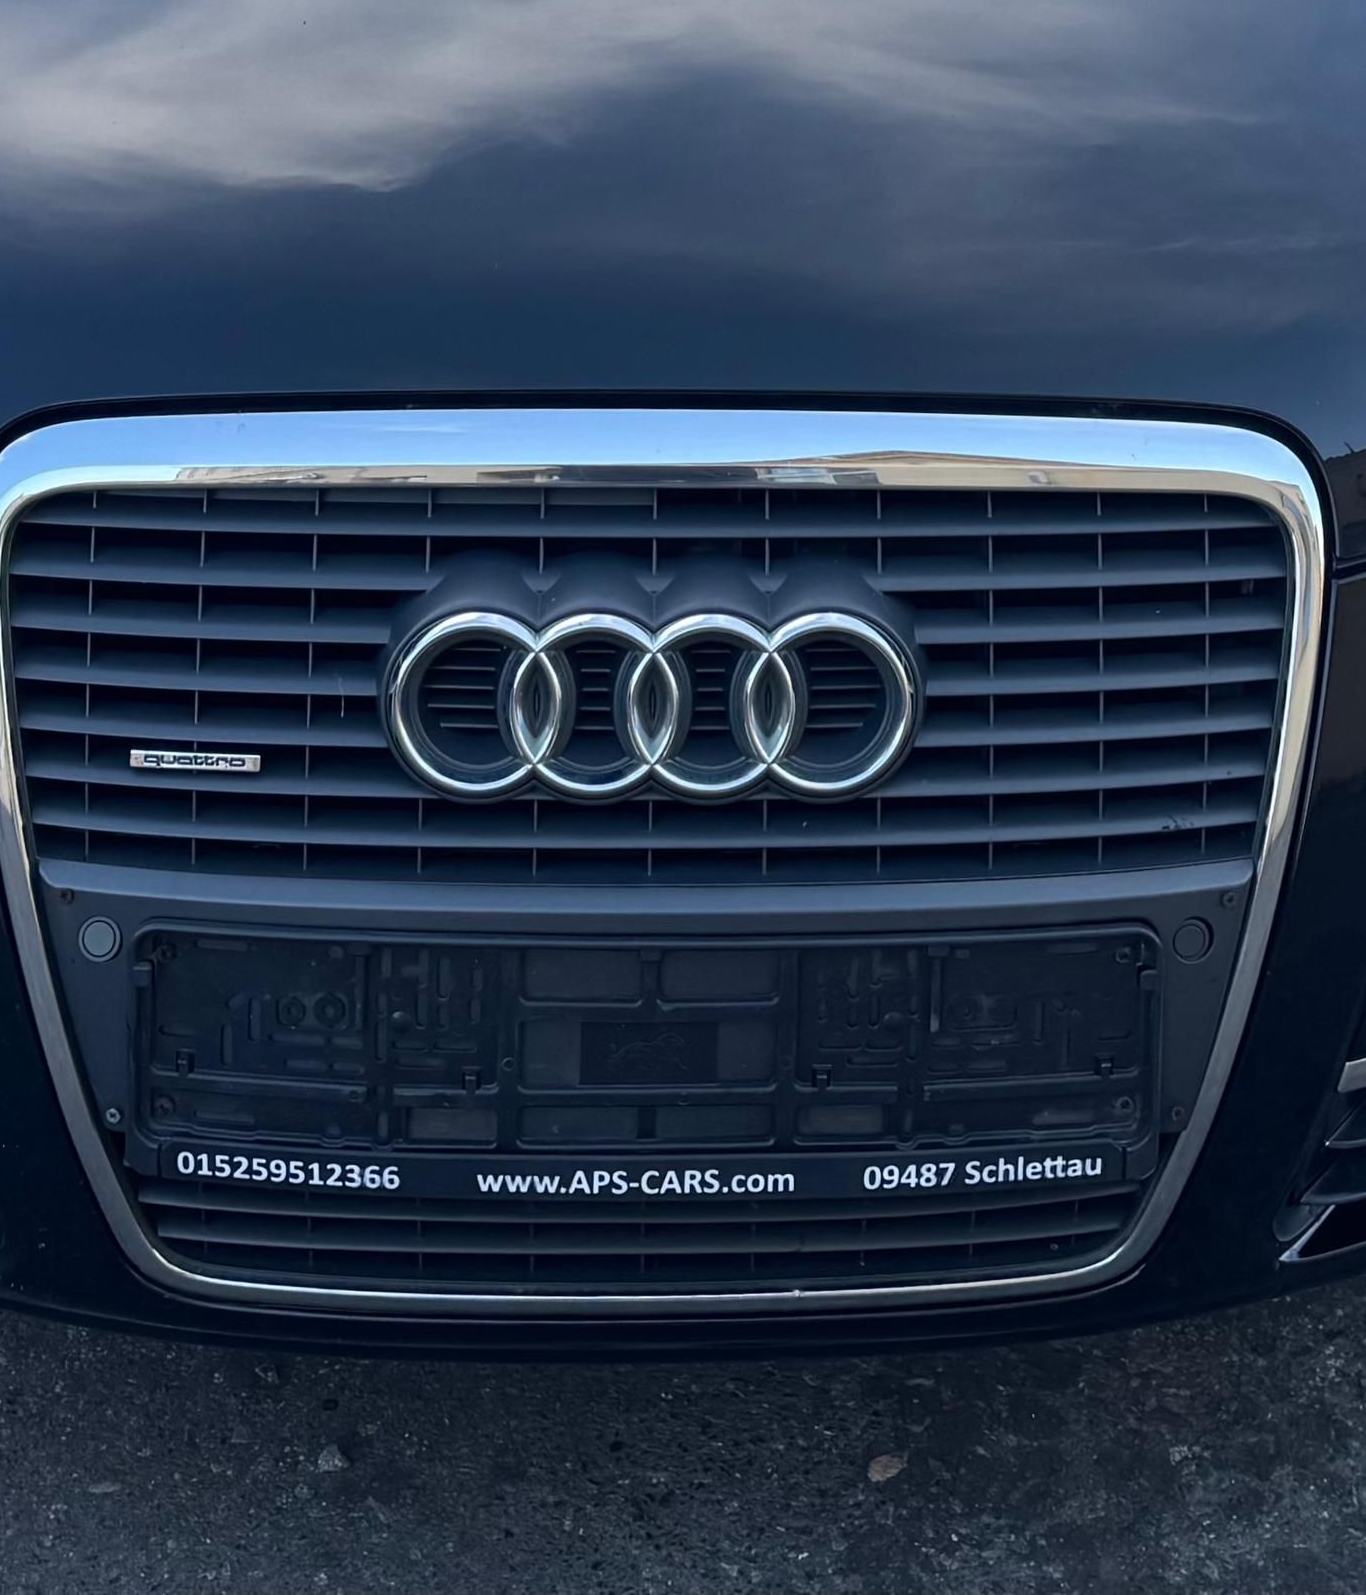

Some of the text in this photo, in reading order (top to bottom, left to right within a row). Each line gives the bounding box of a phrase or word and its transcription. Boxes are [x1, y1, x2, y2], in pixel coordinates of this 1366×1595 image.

[143, 753, 247, 768] quattro
[176, 1151, 401, 1190] 015259512366
[476, 1168, 796, 1196] www.APS-CARS.com
[863, 1154, 1103, 1191] 09487 Schlettau
